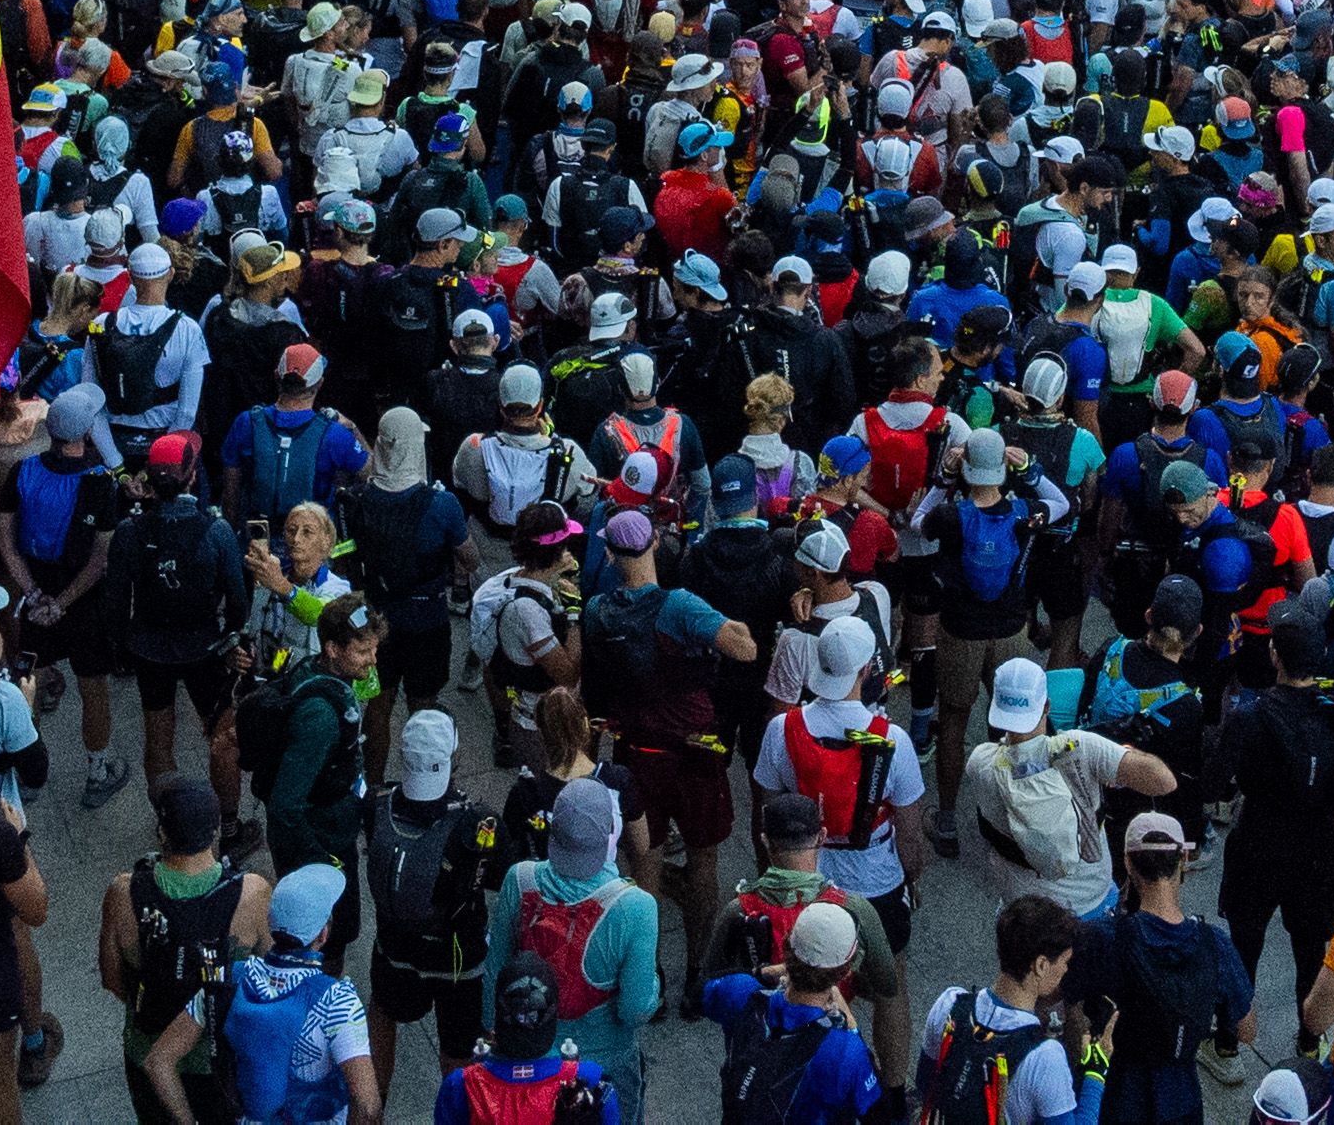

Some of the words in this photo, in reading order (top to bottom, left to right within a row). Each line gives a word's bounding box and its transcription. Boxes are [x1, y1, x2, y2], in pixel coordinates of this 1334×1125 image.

[999, 695, 1029, 707] HOKA
[866, 753, 883, 804] SALOMON
[174, 945, 185, 981] KIPRUN
[738, 1065, 757, 1101] KIPRUN
